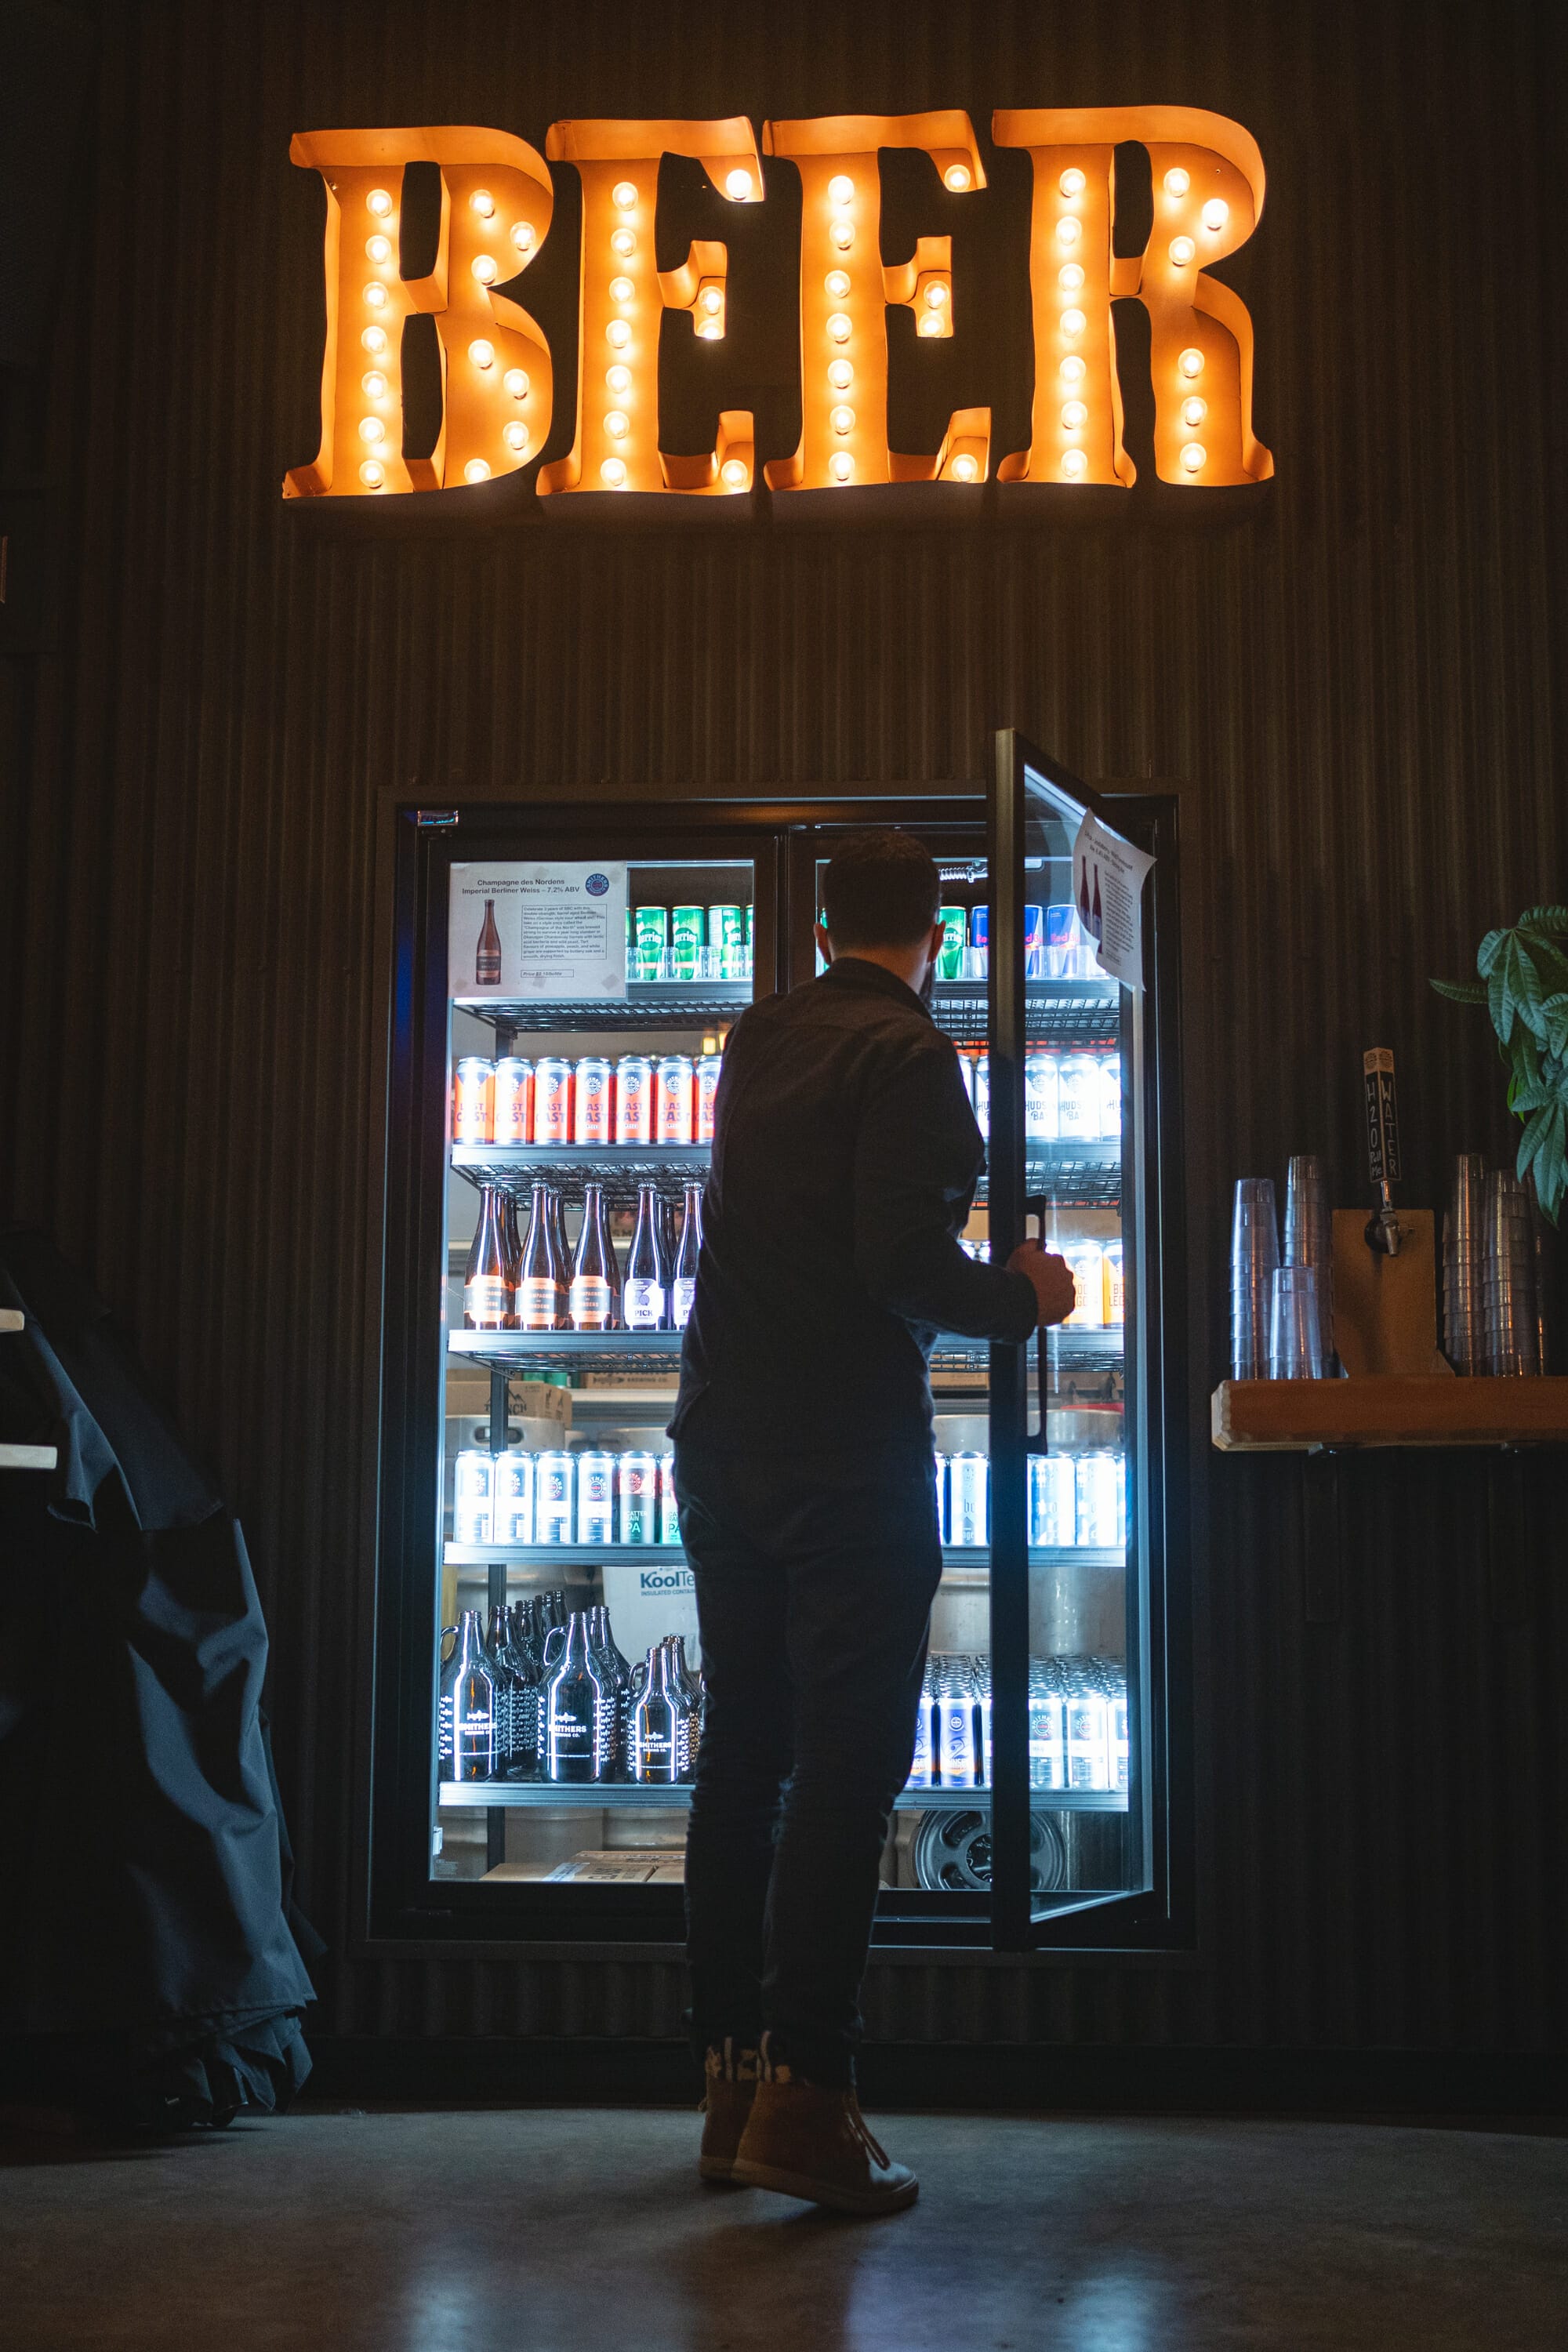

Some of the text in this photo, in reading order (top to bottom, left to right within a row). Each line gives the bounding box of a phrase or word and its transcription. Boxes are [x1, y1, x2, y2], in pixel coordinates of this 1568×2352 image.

[282, 105, 1275, 499] BEER
[586, 1102, 604, 1111] AST
[1030, 1110, 1044, 1120] BA
[1066, 1111, 1080, 1120] BA
[1381, 1078, 1397, 1175] WATER
[640, 1570, 695, 1588] KoolTe
